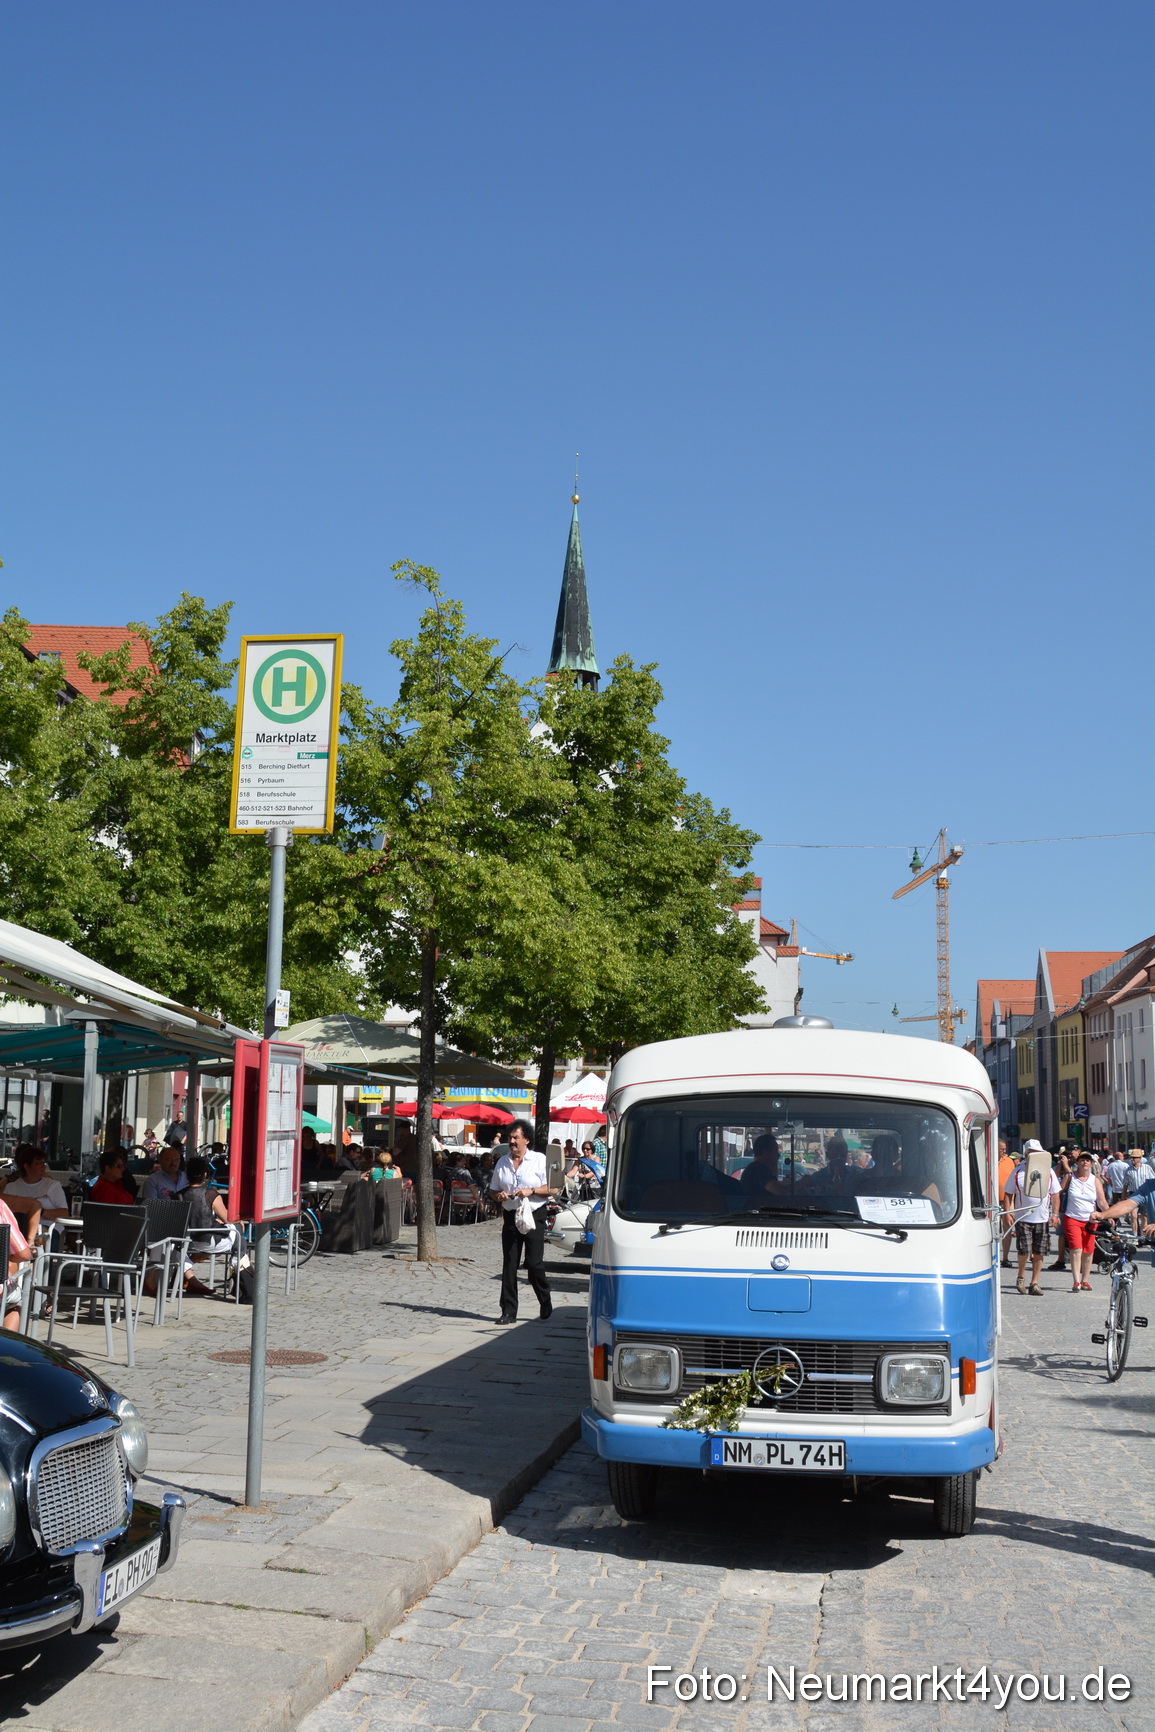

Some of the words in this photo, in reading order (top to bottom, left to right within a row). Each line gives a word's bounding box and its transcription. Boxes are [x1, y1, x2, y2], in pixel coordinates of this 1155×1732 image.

[271, 666, 307, 707] H
[255, 733, 317, 745] Marktplatz
[361, 1085, 382, 1095] WC
[890, 1198, 913, 1207] 581
[724, 1441, 752, 1464] NM
[766, 1442, 794, 1465] PL
[799, 1444, 843, 1467] 74H
[104, 1568, 119, 1607] EI
